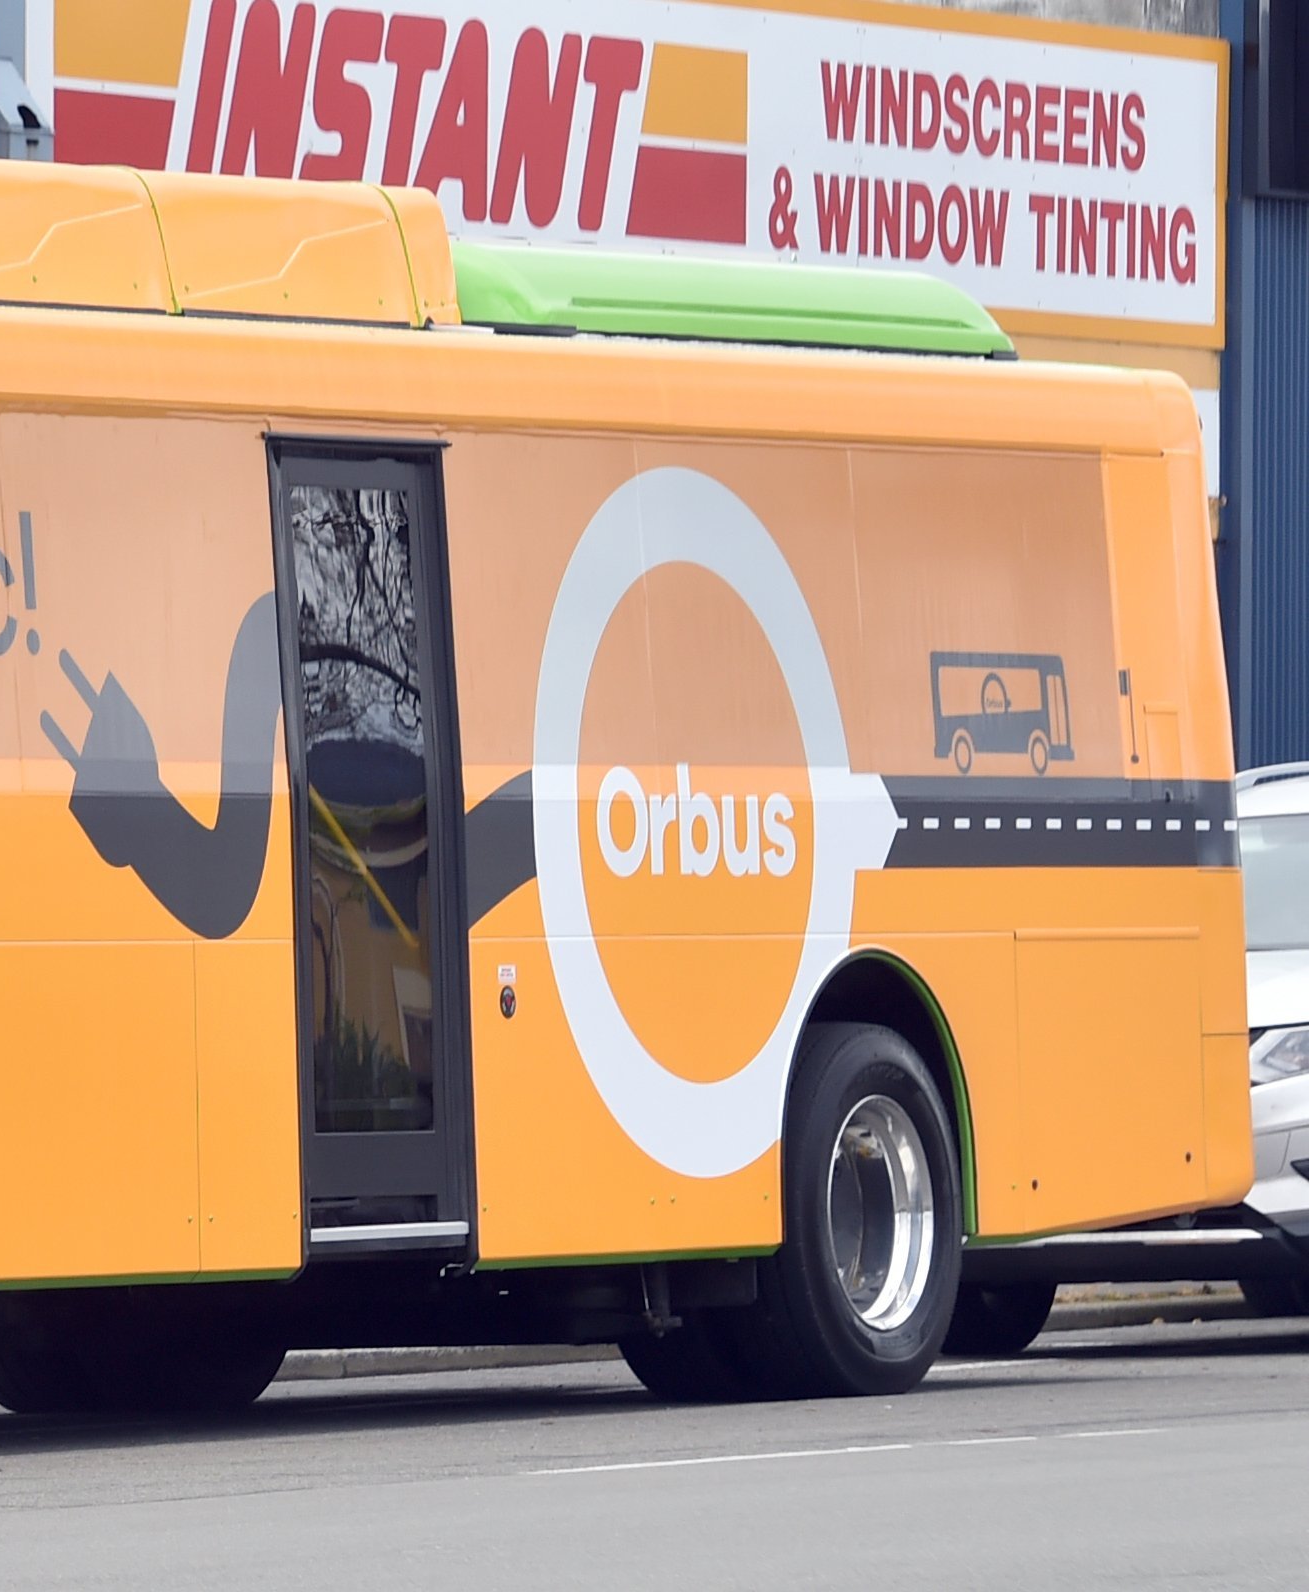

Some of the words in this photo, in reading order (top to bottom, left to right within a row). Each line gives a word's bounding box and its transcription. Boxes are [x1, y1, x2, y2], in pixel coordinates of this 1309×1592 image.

[185, 0, 644, 232] INSTANT
[820, 59, 1146, 172] WINDSCREENS
[768, 165, 799, 251] &
[813, 172, 1011, 269] WINDOW
[1028, 193, 1197, 285] TINTING
[596, 762, 797, 877] Orbus
